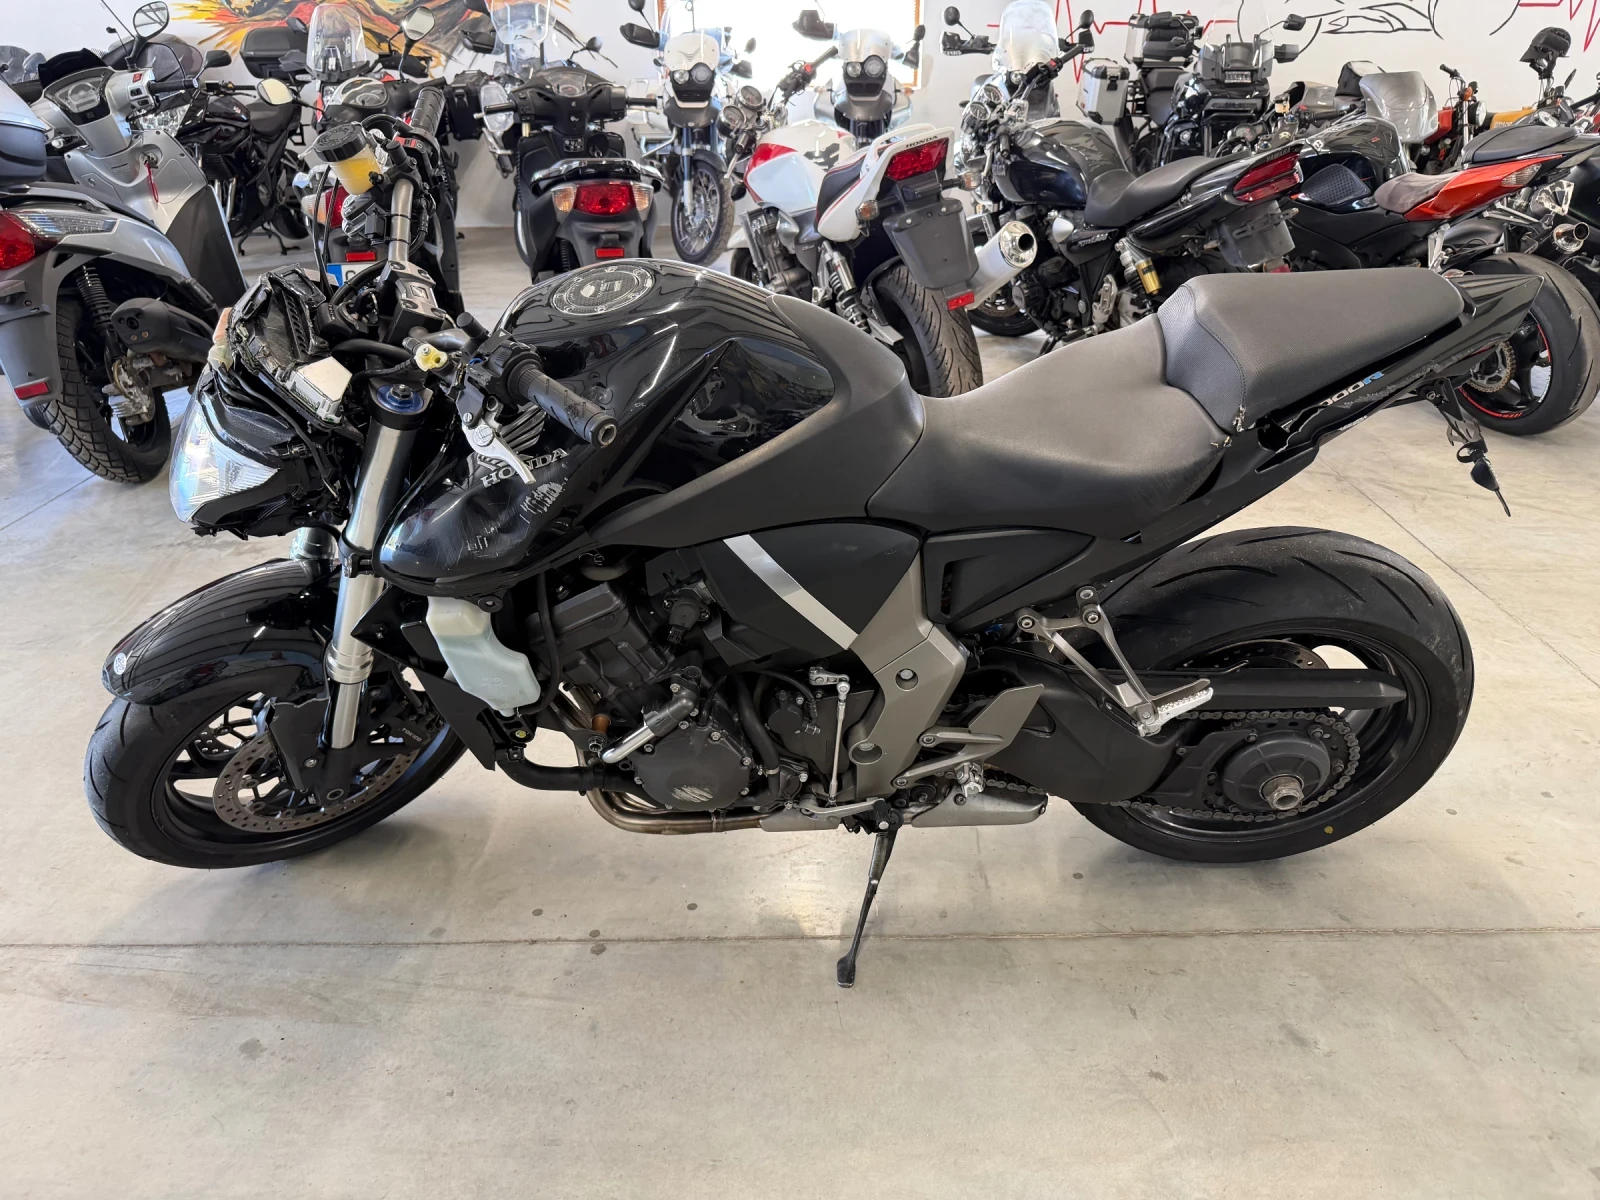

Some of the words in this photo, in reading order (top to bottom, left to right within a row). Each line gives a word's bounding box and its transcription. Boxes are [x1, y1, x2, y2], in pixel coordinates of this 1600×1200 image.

[905, 135, 938, 148] HONDA
[1266, 147, 1291, 162] YAMAHA
[402, 727, 422, 742] TOKICO
